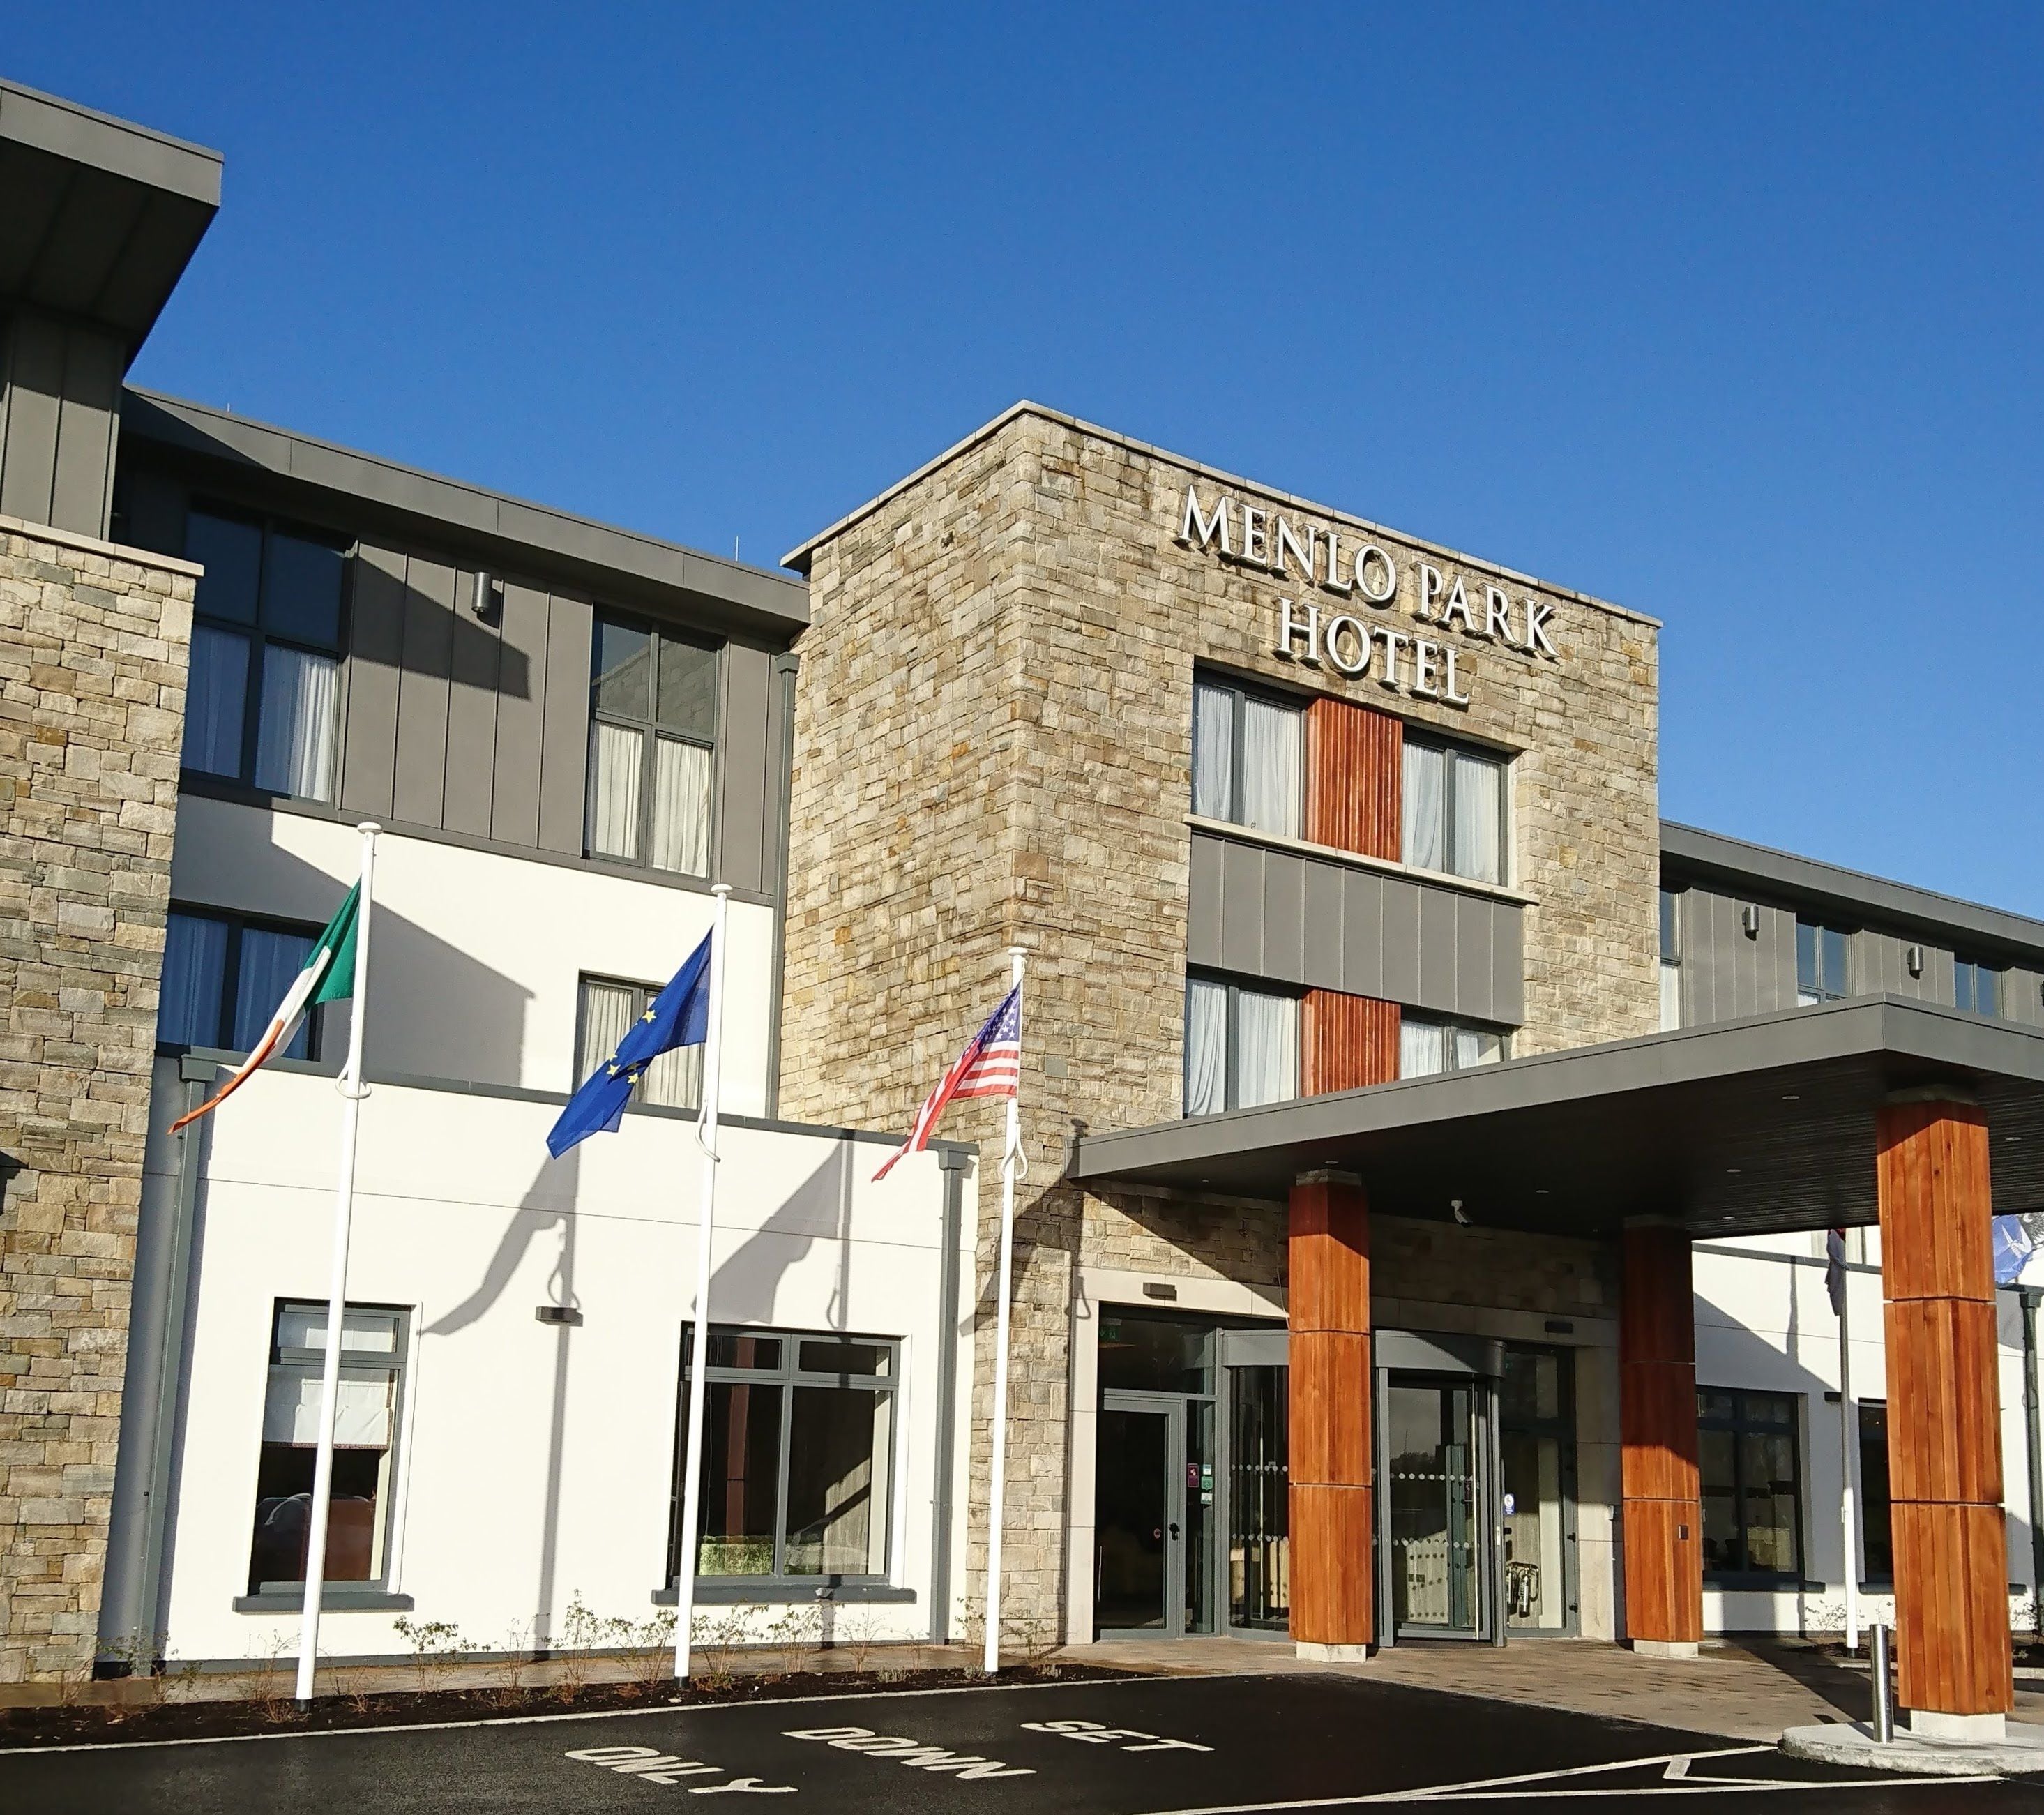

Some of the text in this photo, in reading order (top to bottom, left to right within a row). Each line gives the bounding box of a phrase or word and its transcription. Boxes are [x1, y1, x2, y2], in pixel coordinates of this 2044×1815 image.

[1179, 484, 1561, 658] MENLO PARK
[1277, 596, 1469, 705] HOTEL
[779, 1726, 1038, 1780] DOWN
[1020, 1719, 1216, 1752] SET
[563, 1745, 800, 1795] ONLY
